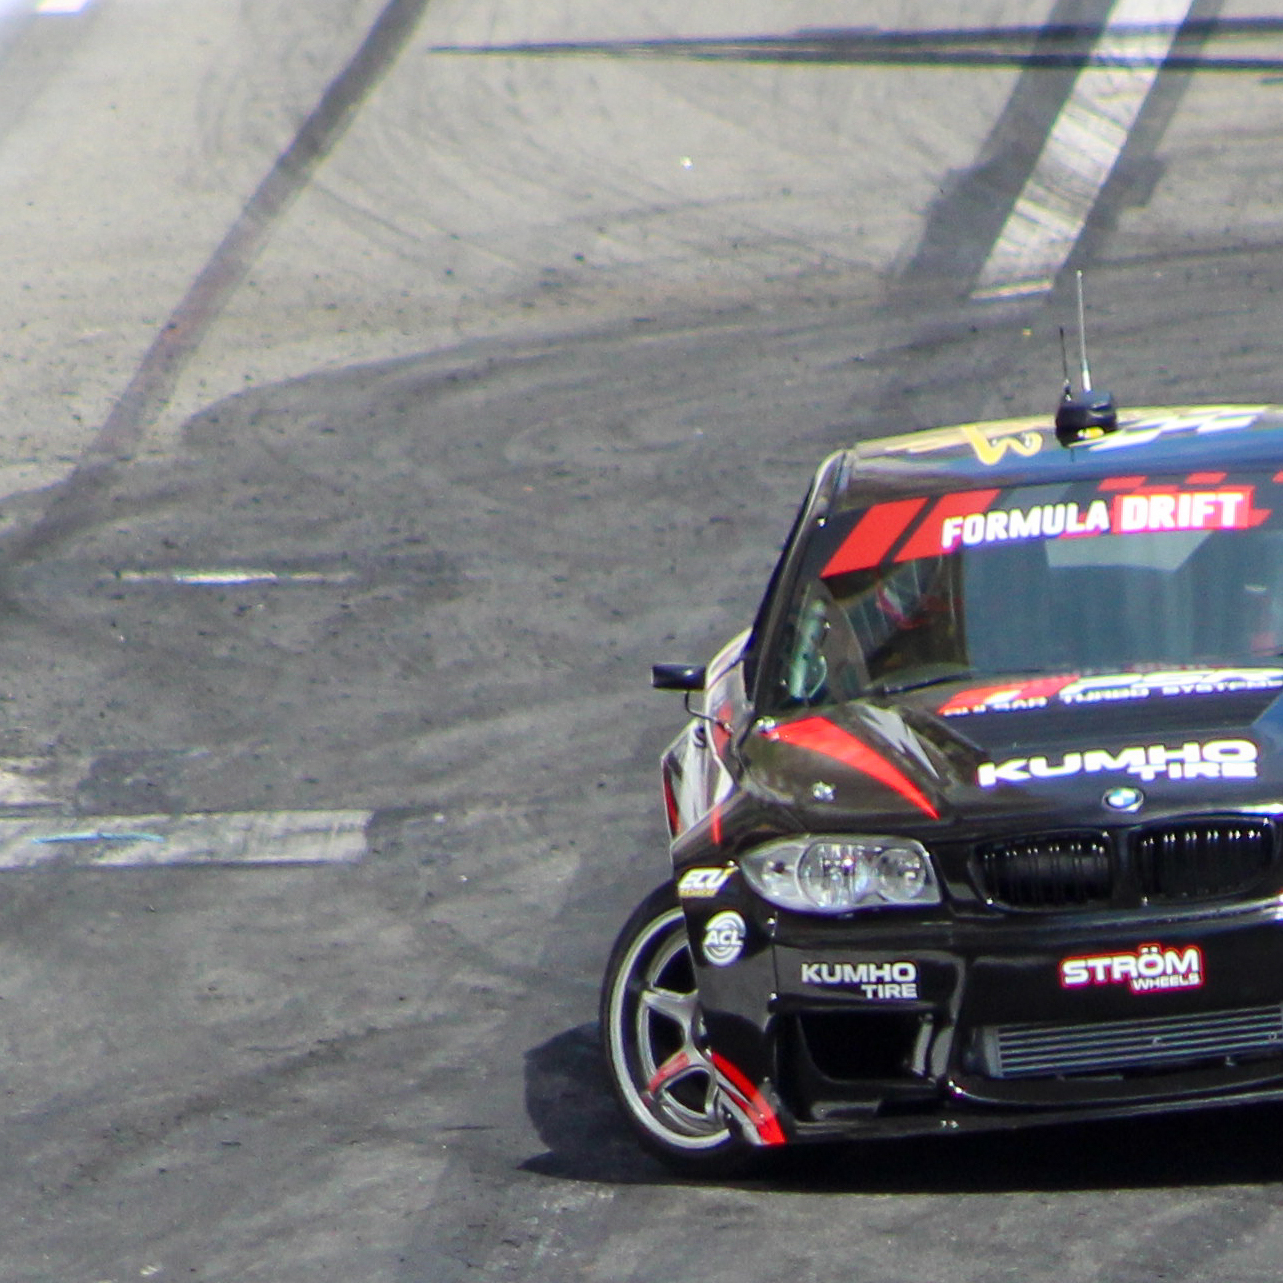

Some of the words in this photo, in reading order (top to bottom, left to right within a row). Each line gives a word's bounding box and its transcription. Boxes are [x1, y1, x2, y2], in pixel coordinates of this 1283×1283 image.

[941, 500, 1111, 549] FORMULA
[1120, 492, 1245, 531] DRIFT
[976, 738, 1259, 788] KUMHO
[1126, 761, 1258, 782] TIRE
[678, 866, 739, 891] ECU
[703, 929, 745, 947] ACL
[801, 962, 917, 984] KUMHO
[1061, 946, 1200, 985] STRÖM
[861, 983, 918, 1000] TIRE
[1132, 973, 1201, 991] WHEELS
